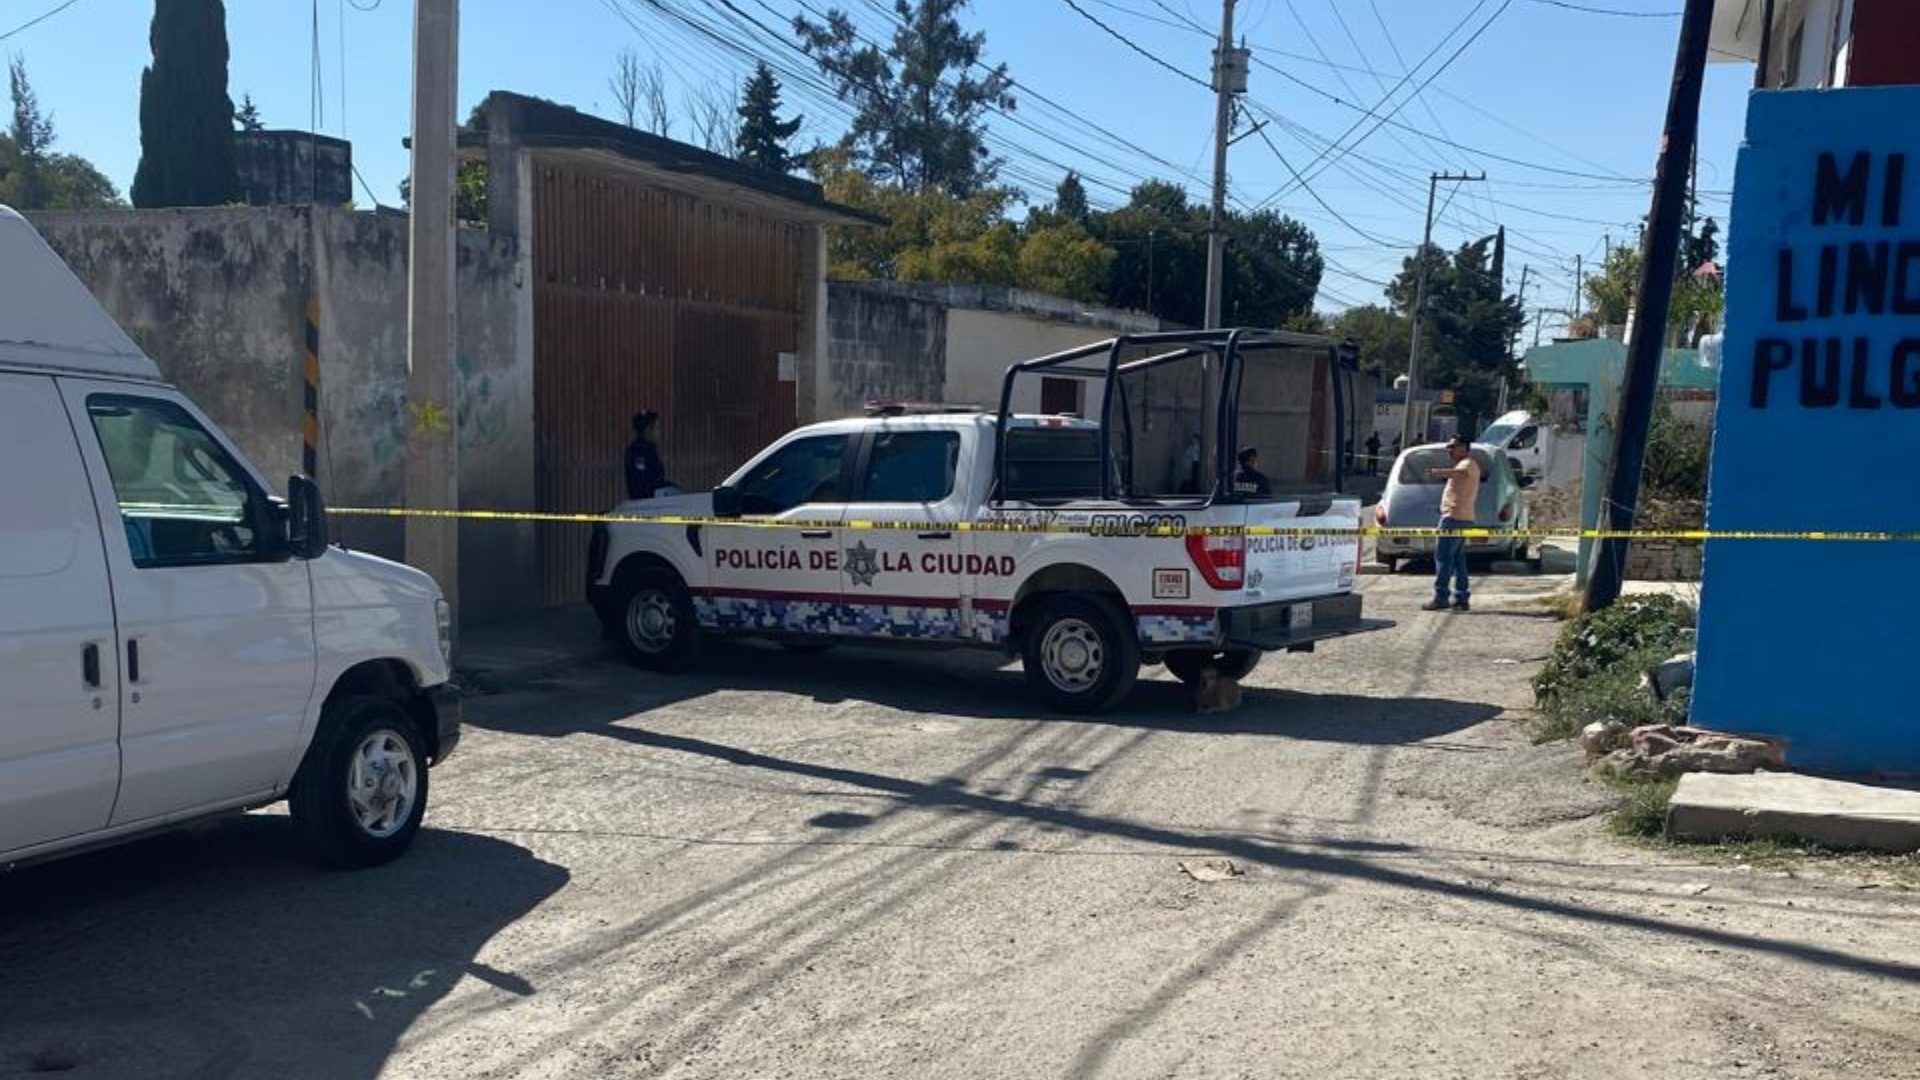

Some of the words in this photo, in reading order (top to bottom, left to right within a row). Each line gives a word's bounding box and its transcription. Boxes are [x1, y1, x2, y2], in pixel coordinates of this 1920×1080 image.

[1812, 151, 1904, 227] MI
[715, 545, 802, 570] POLICÍA
[809, 550, 838, 570] DE
[883, 551, 913, 573] LA
[920, 552, 1016, 577] CIUDAD
